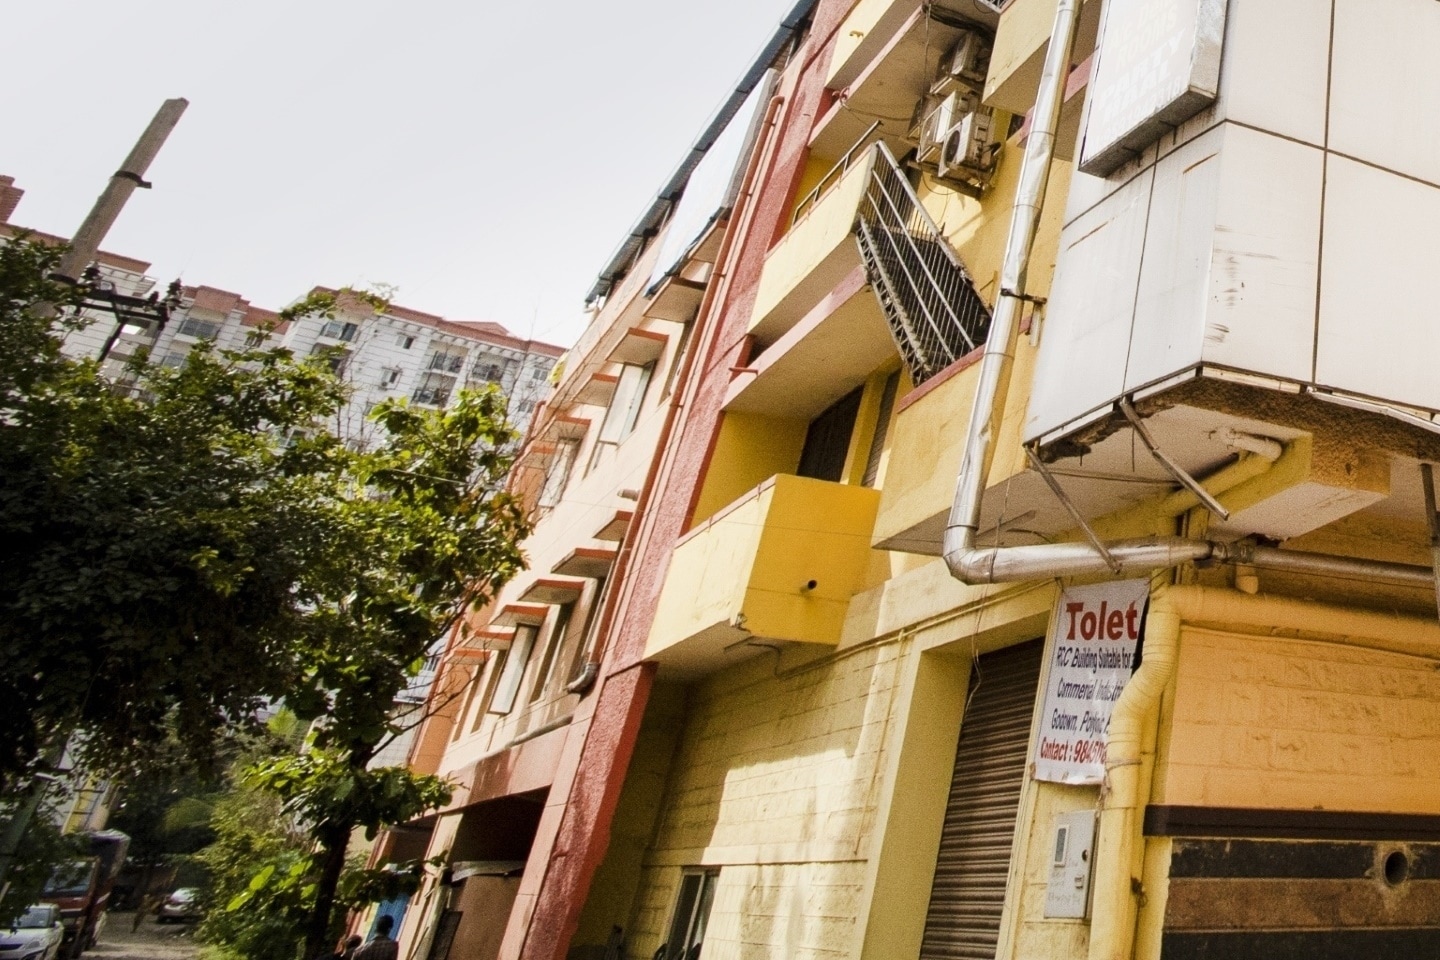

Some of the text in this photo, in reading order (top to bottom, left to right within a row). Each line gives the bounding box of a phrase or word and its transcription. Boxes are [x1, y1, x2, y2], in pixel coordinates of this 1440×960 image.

[1116, 3, 1178, 72] ROOMS
[1099, 27, 1186, 110] PARTY
[1066, 600, 1138, 640] Tolet
[1071, 647, 1098, 673] Building
[1099, 647, 1121, 669] Suitable
[1121, 647, 1131, 669] for
[1040, 737, 1069, 762] Contact
